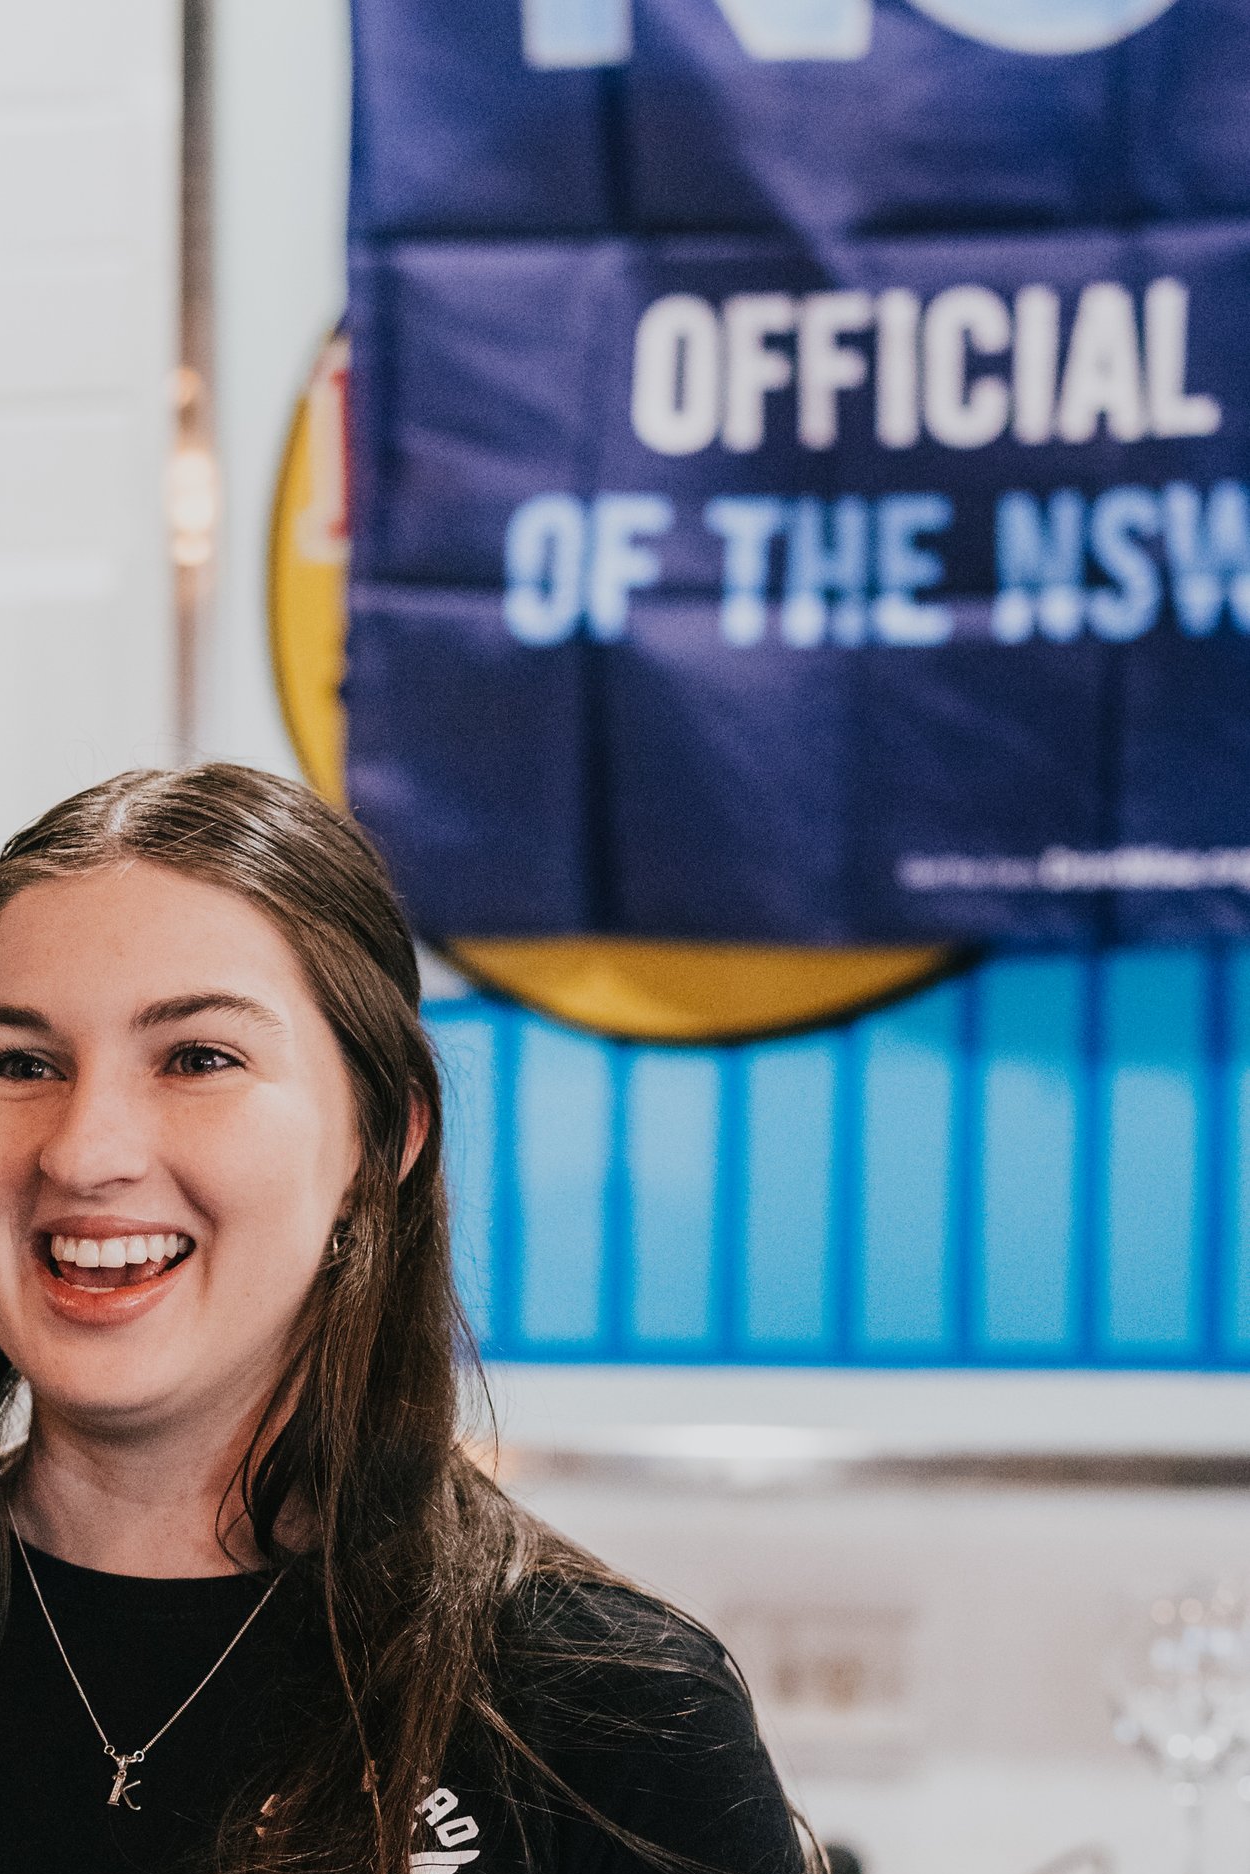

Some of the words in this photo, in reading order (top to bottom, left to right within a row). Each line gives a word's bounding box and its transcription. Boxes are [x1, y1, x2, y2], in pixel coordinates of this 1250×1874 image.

[631, 277, 1220, 455] OFFICIAL
[504, 492, 673, 648] OF
[705, 491, 952, 648] THE
[992, 479, 1250, 645] NSW
